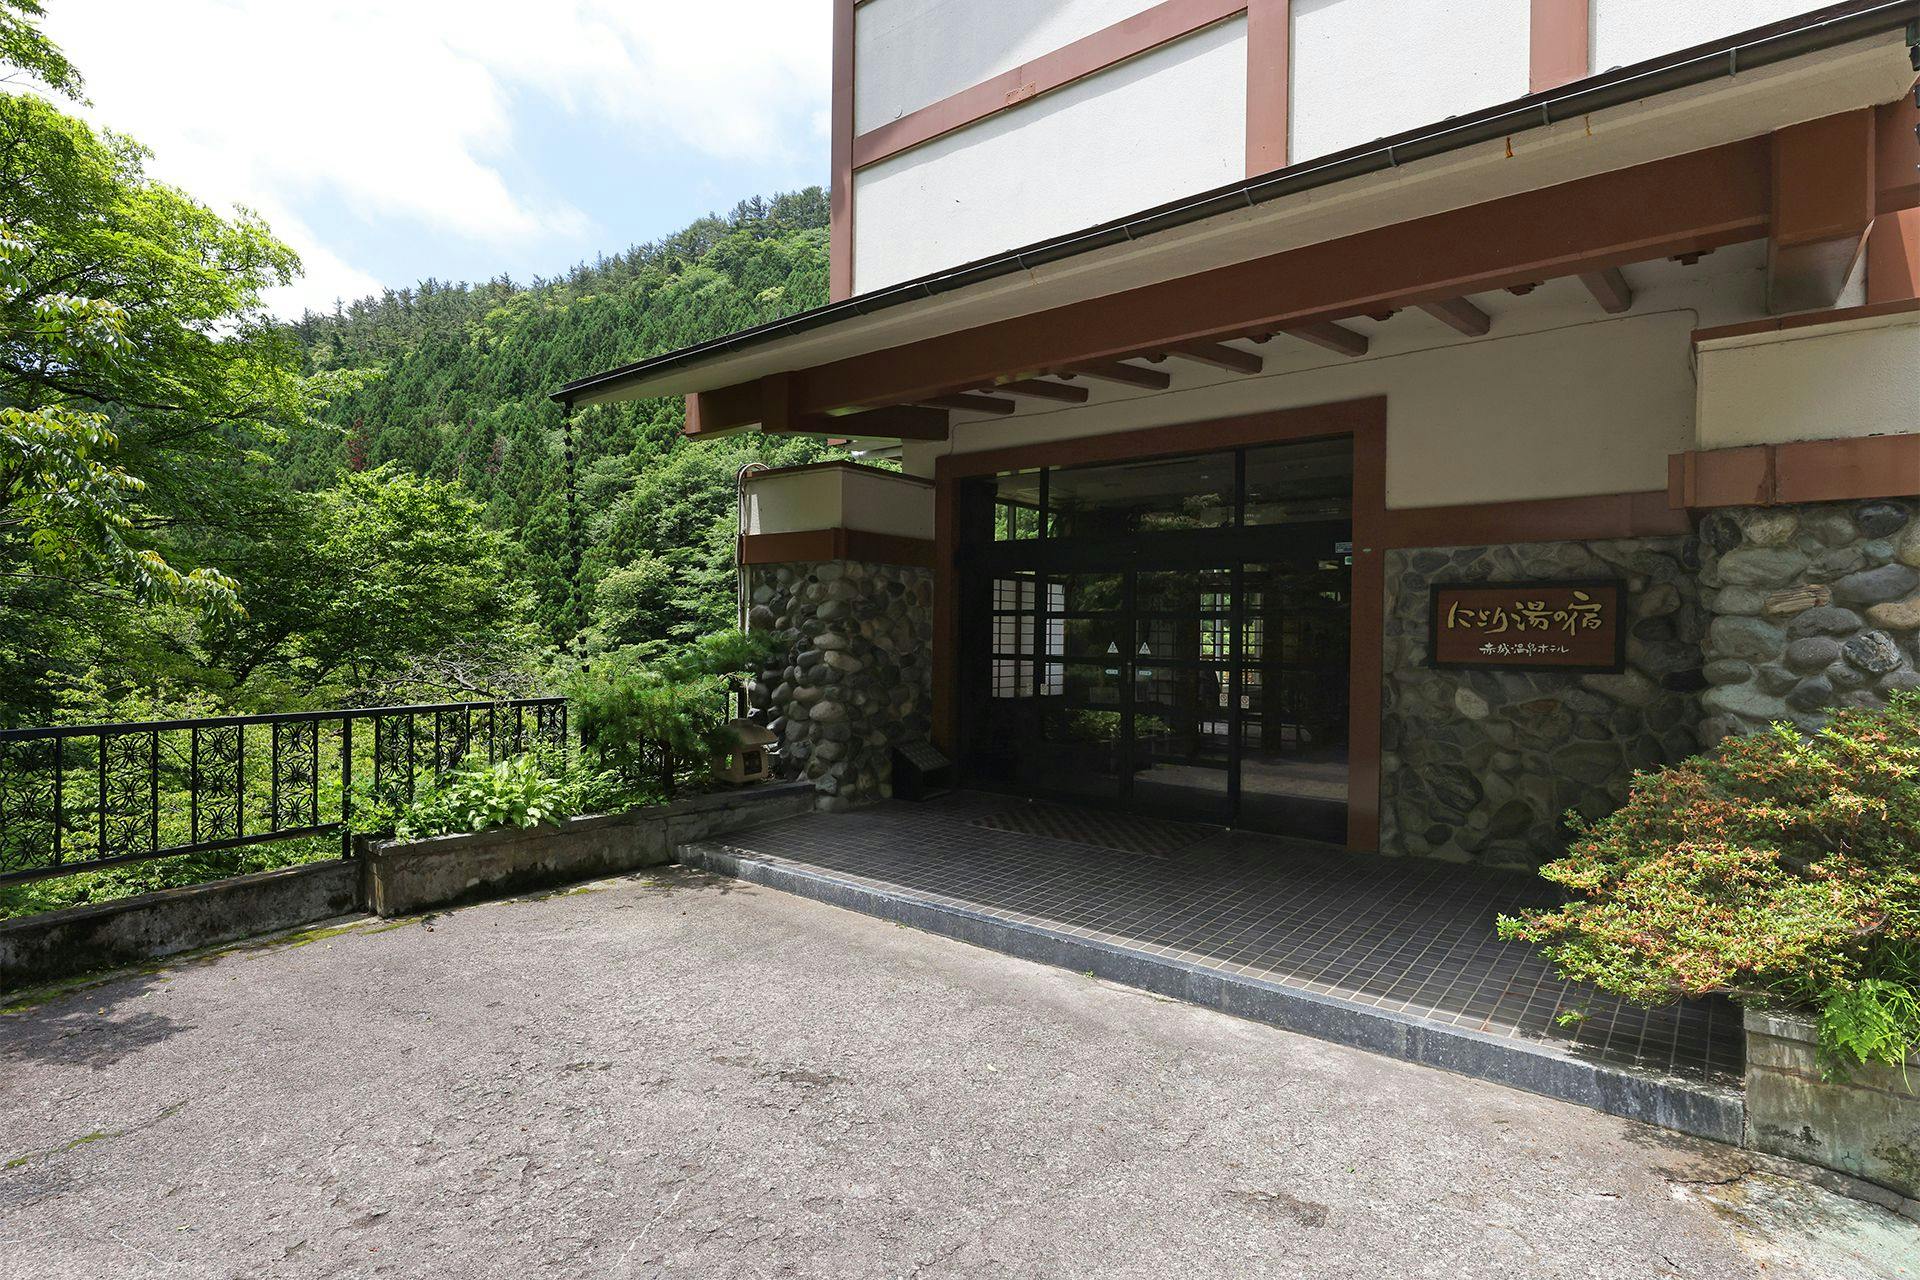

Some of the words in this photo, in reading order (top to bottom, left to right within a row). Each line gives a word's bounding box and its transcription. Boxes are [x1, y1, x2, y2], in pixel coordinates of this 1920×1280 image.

[1447, 590, 1602, 636] にごり湯の宿
[1479, 642, 1570, 657] 赤城温泉ホテル
